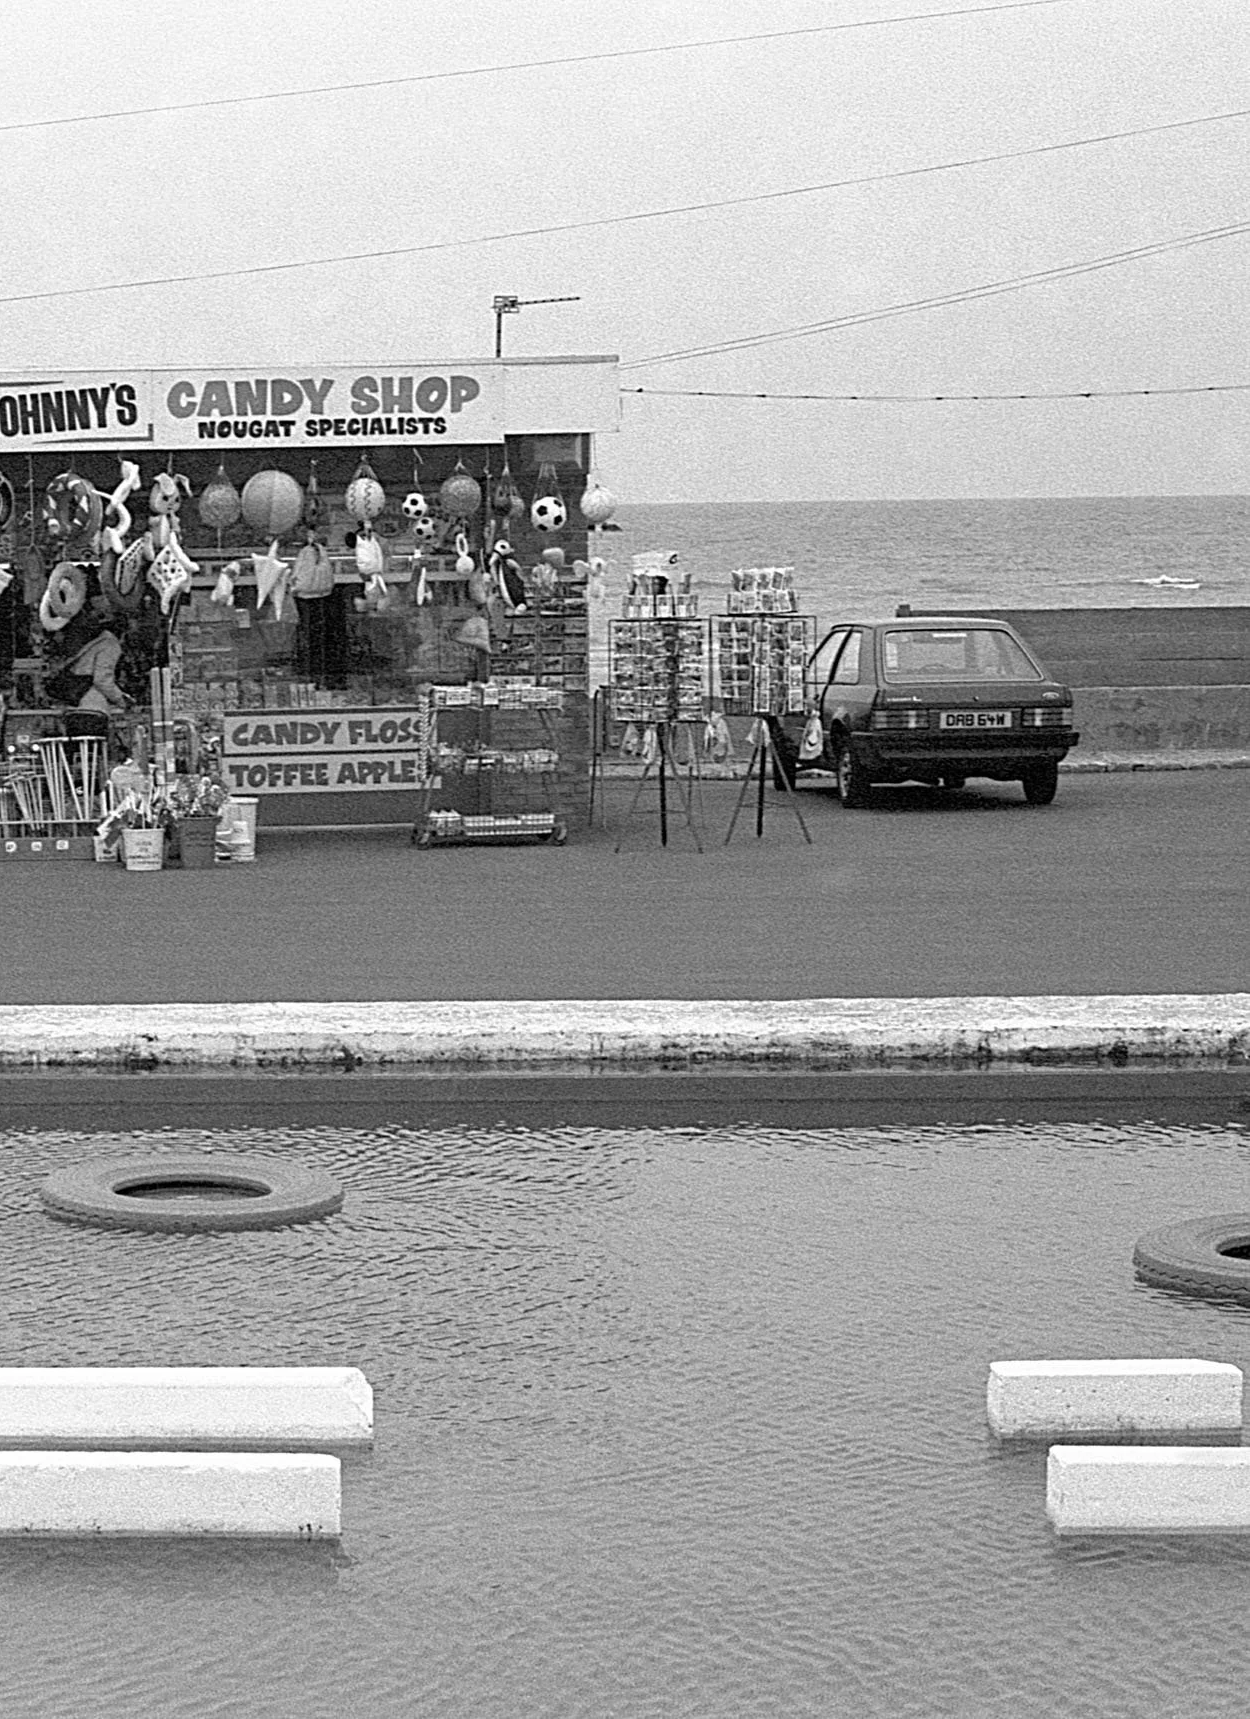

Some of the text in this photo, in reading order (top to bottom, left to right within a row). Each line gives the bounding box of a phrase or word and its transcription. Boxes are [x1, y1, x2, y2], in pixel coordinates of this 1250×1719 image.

[166, 375, 481, 419] CANDY SHOP
[197, 417, 447, 439] NOUGAT SPECIALISTS
[231, 721, 342, 747] CANDY
[228, 759, 423, 788] TOFFEE APPLE
